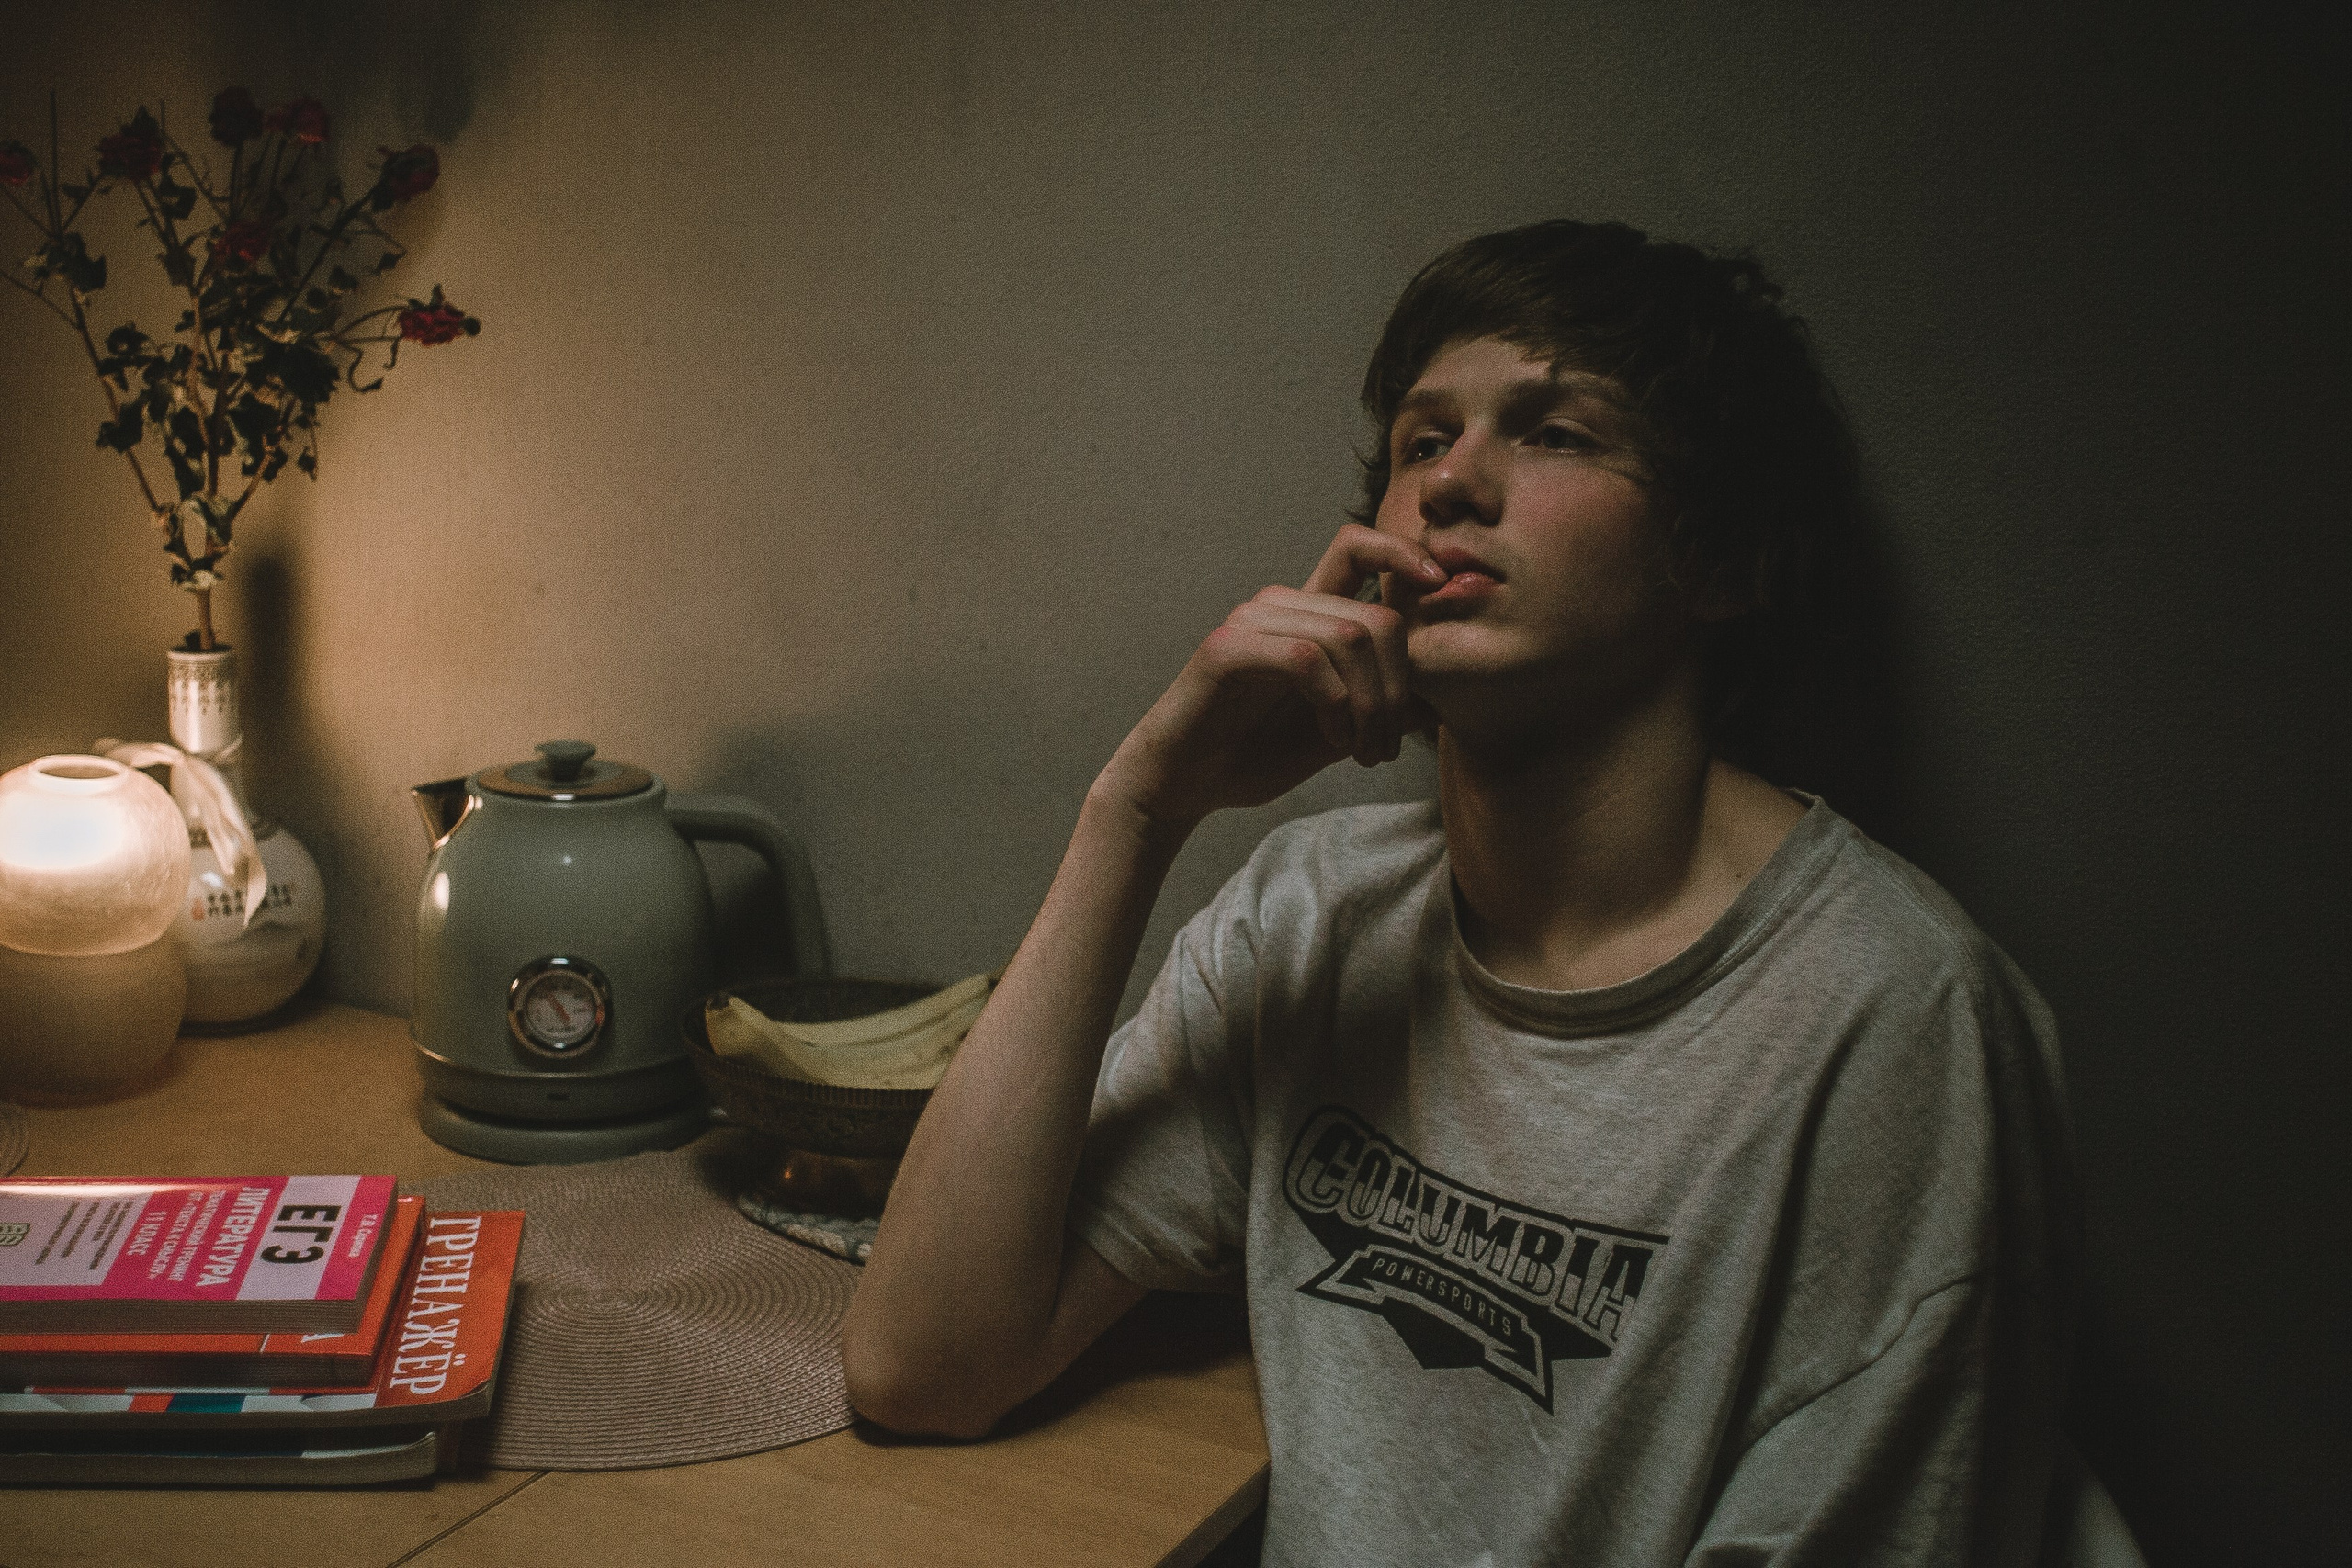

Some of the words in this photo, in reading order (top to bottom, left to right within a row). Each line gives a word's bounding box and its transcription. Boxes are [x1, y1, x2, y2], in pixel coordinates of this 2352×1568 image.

[128, 1224, 161, 1255] КЛАСС
[196, 1187, 270, 1286] ЛИТЕРАТУРА
[261, 1205, 341, 1264] ЕГЭ
[1290, 1111, 1659, 1343] COLUMBIA
[1372, 1258, 1513, 1337] POWERSPORTS
